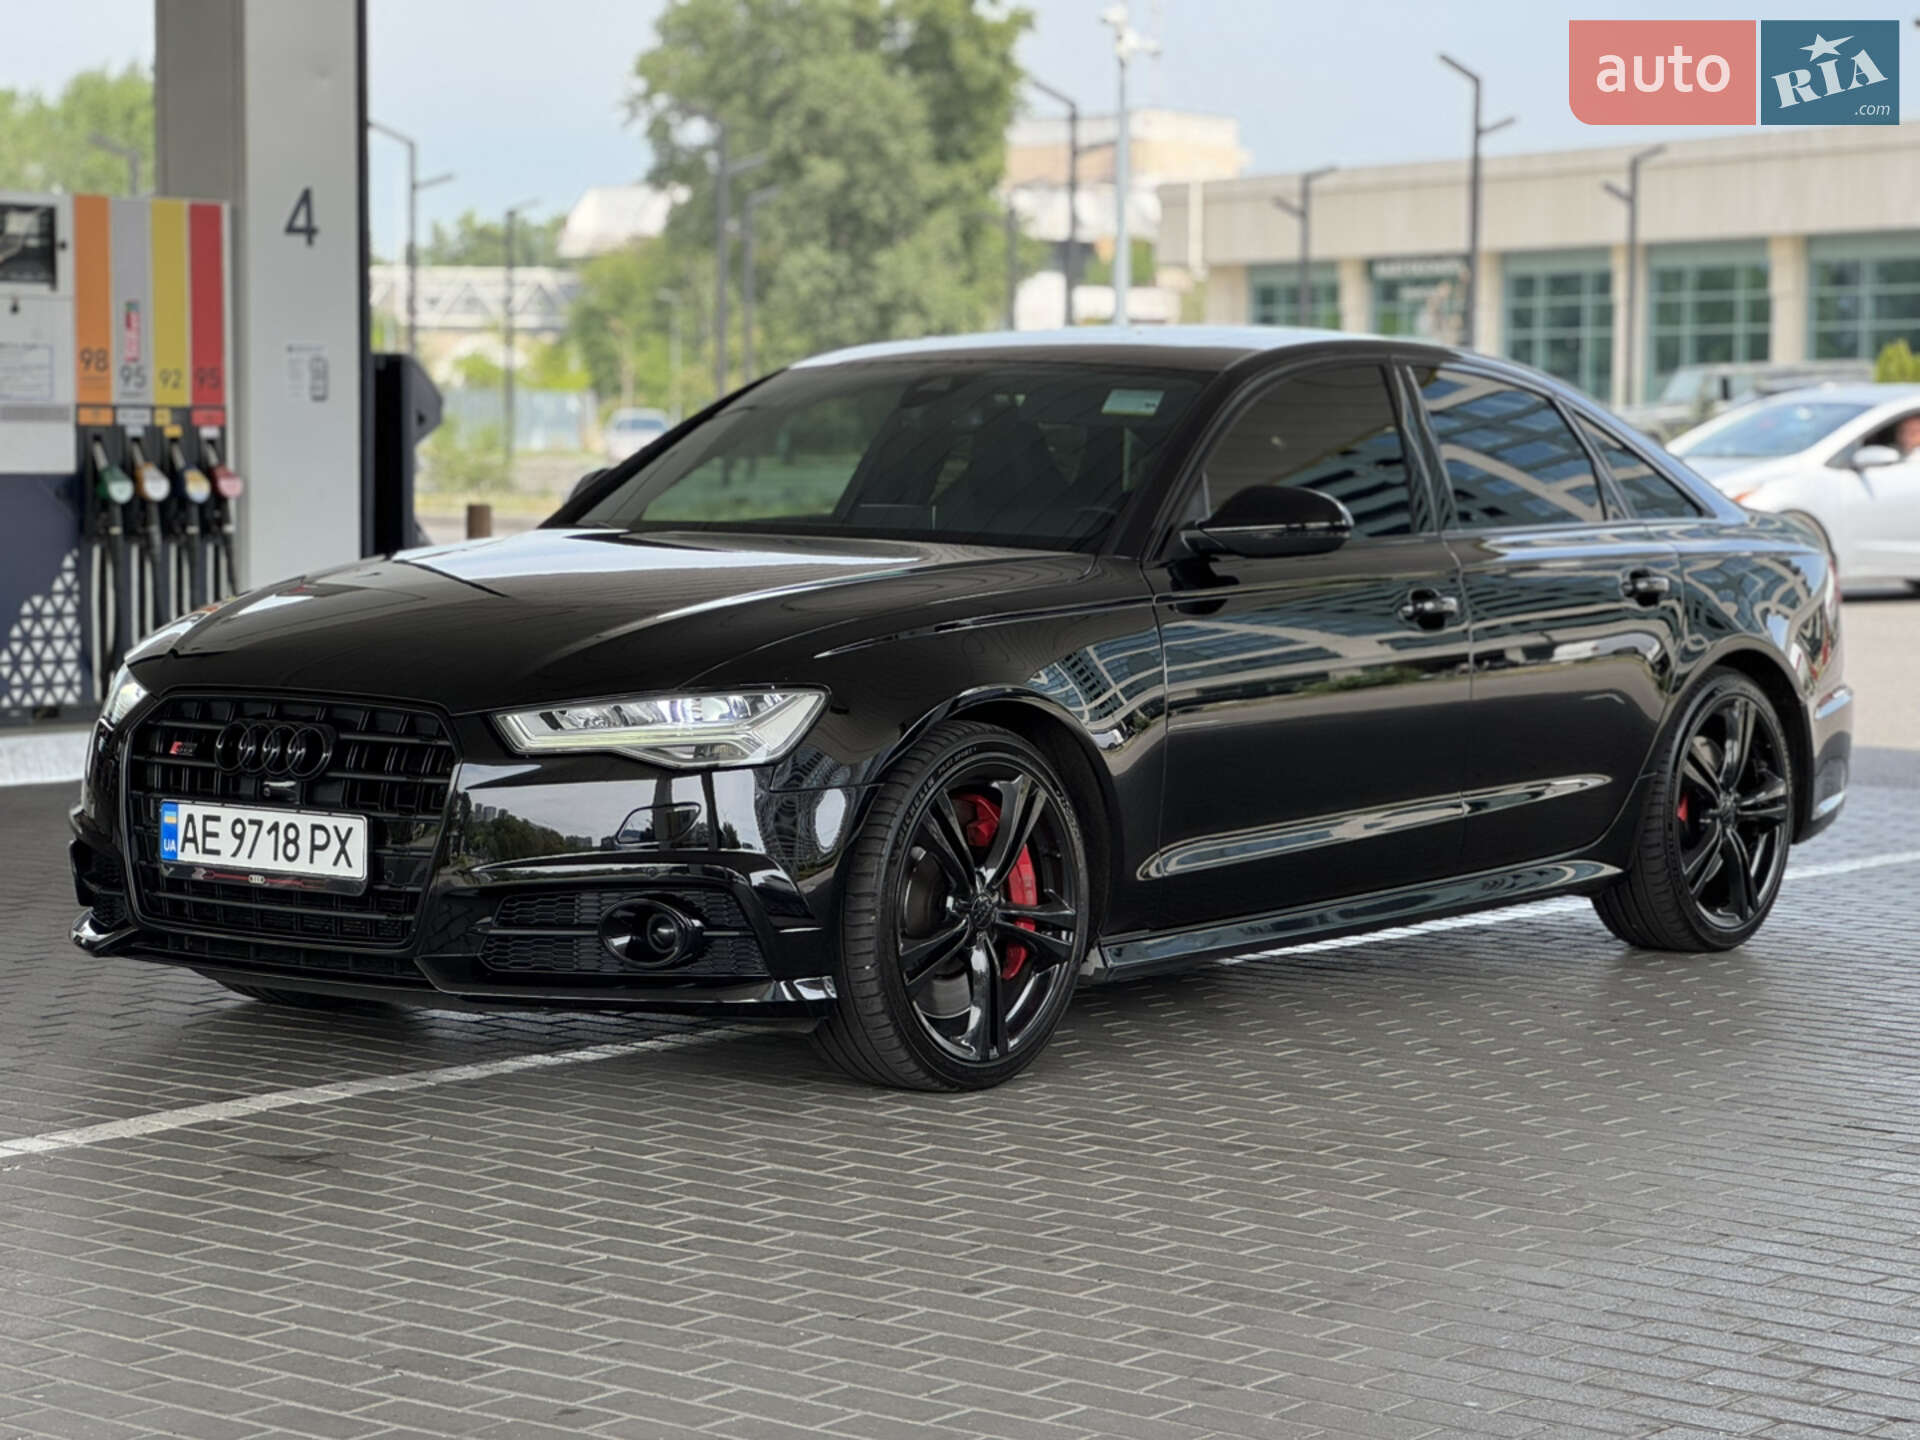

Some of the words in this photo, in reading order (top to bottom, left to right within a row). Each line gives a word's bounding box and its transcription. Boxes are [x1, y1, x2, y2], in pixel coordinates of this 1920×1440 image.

[285, 187, 319, 248] 4
[80, 347, 108, 373] 98
[120, 365, 147, 389] 95
[159, 368, 182, 390] 92
[196, 367, 220, 390] 95
[163, 838, 177, 853] UA
[179, 813, 222, 856] AE
[230, 817, 300, 863] 9718
[309, 823, 353, 869] PX
